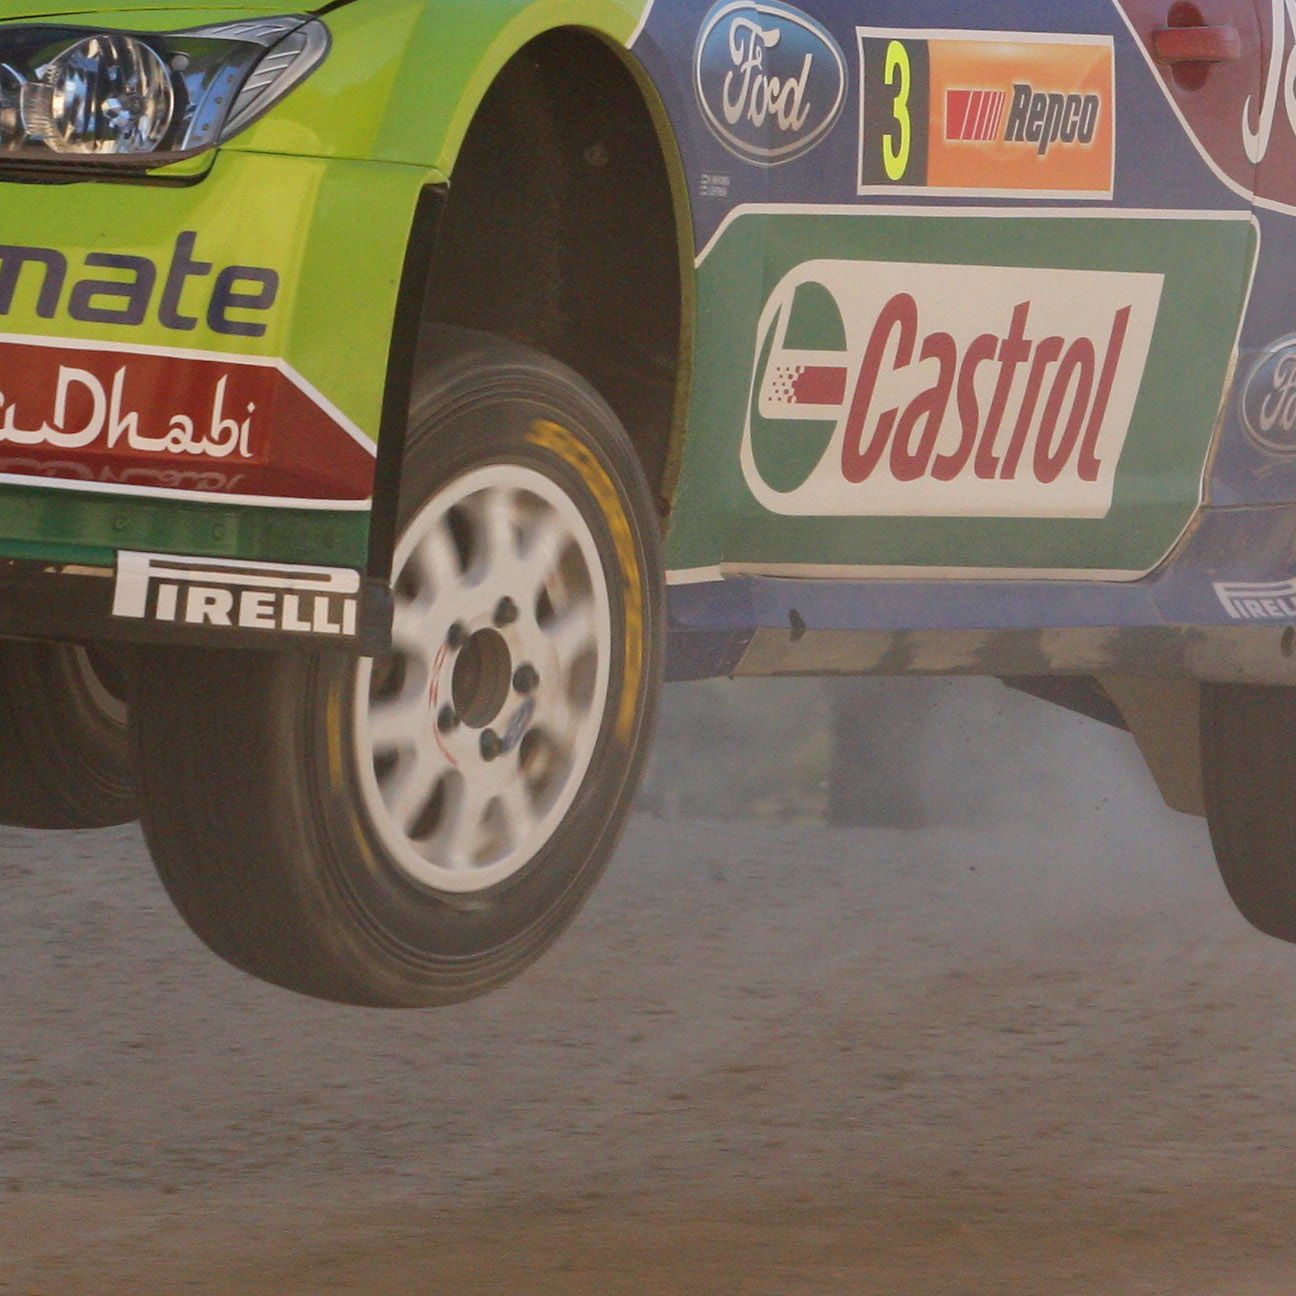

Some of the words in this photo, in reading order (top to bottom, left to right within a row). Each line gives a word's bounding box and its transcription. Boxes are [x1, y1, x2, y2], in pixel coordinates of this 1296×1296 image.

[722, 16, 812, 132] Ford
[881, 39, 911, 181] 3
[1004, 83, 1100, 158] Repco
[51, 364, 256, 459] Dhabi
[840, 292, 1133, 484] Castrol
[112, 549, 361, 636] PIRELLI
